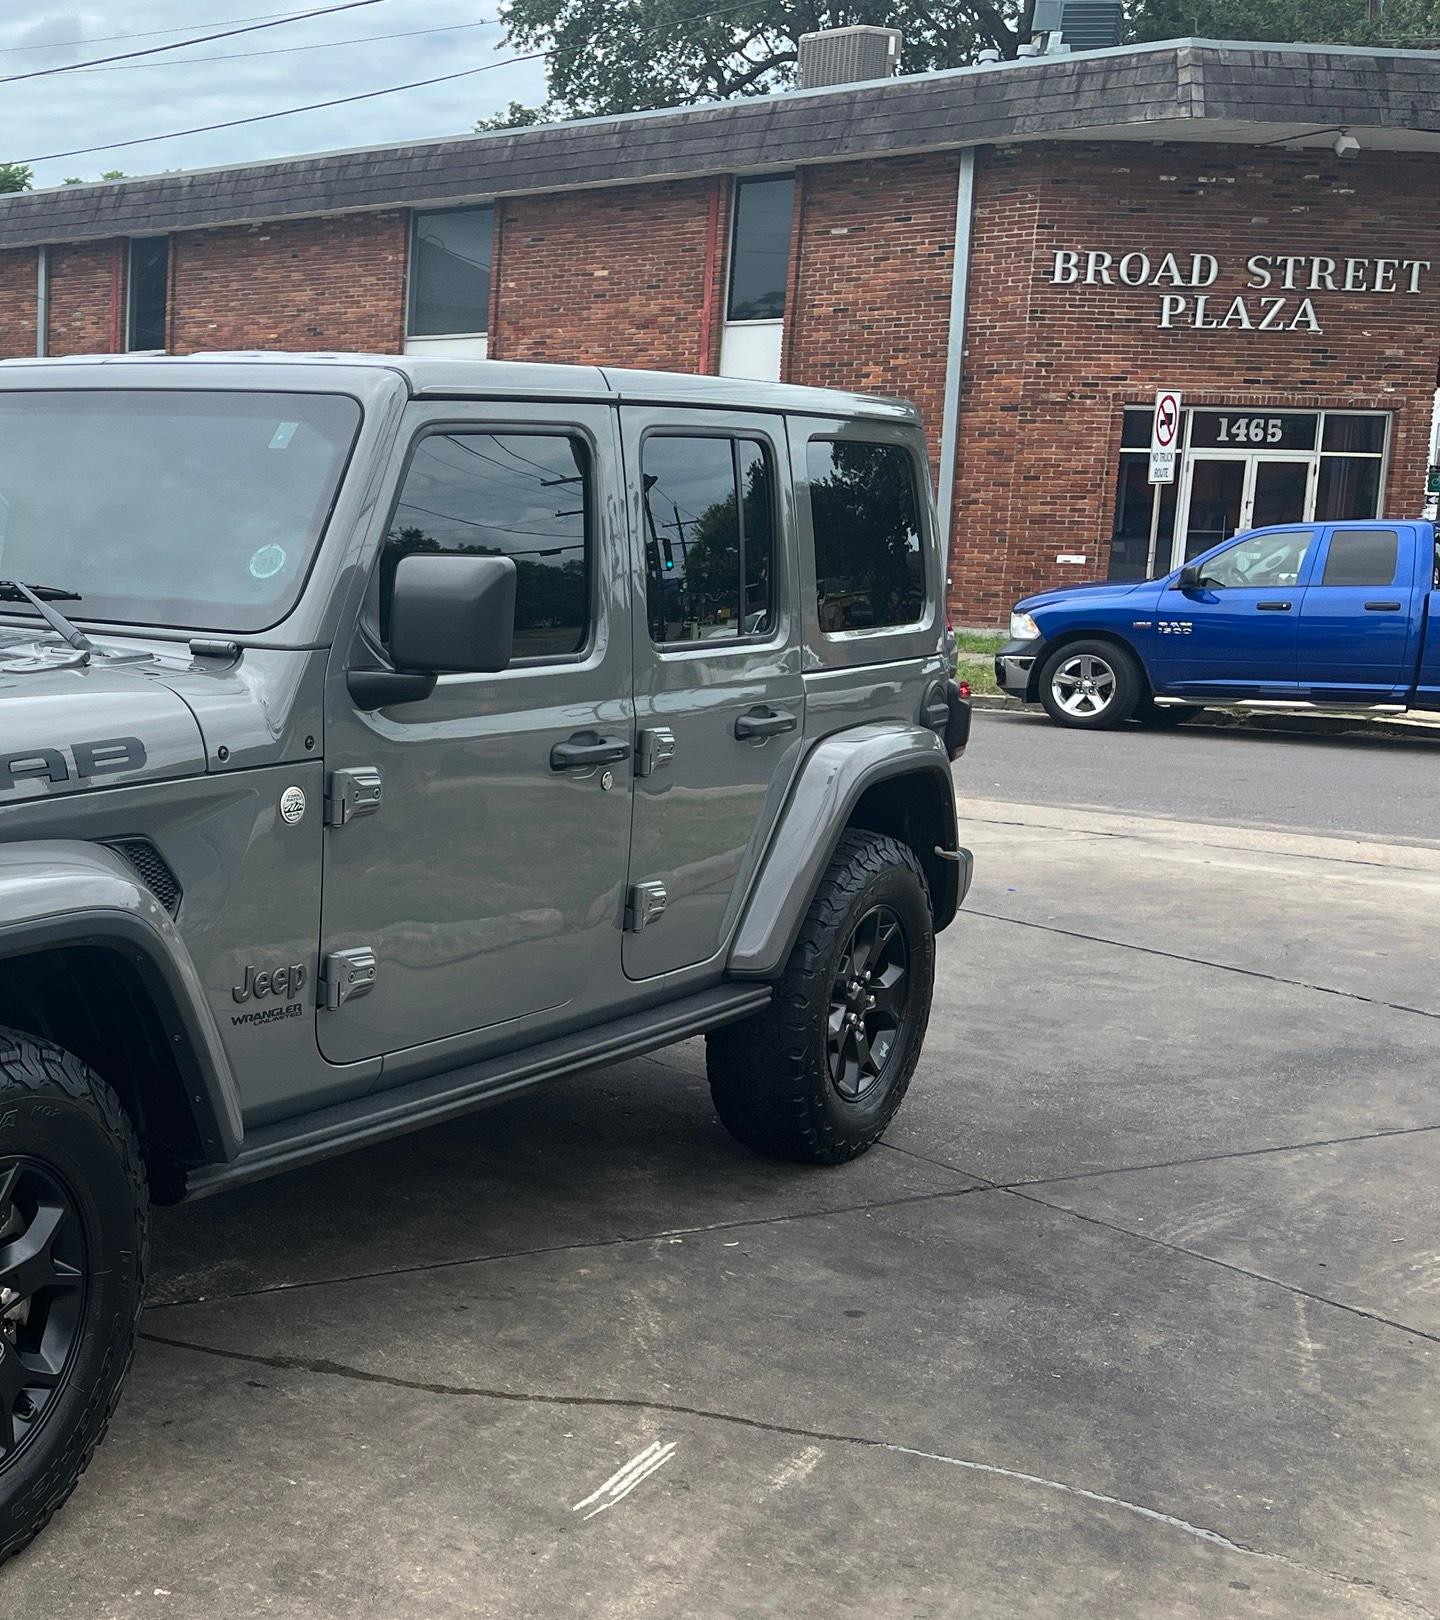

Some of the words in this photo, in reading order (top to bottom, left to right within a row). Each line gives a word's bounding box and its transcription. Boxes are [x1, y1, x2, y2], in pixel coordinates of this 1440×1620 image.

[1049, 250, 1219, 287] BROAD
[1247, 254, 1431, 294] STREET
[1157, 294, 1323, 335] PLAZA
[1216, 417, 1283, 443] 1465
[1152, 452, 1159, 463] NO
[1159, 452, 1174, 463] TRUCK
[1153, 468, 1169, 479] ROUTE
[232, 963, 307, 1003] Jeep
[231, 1003, 302, 1026] WRANGLER
[253, 1011, 303, 1026] UNLIMITED
